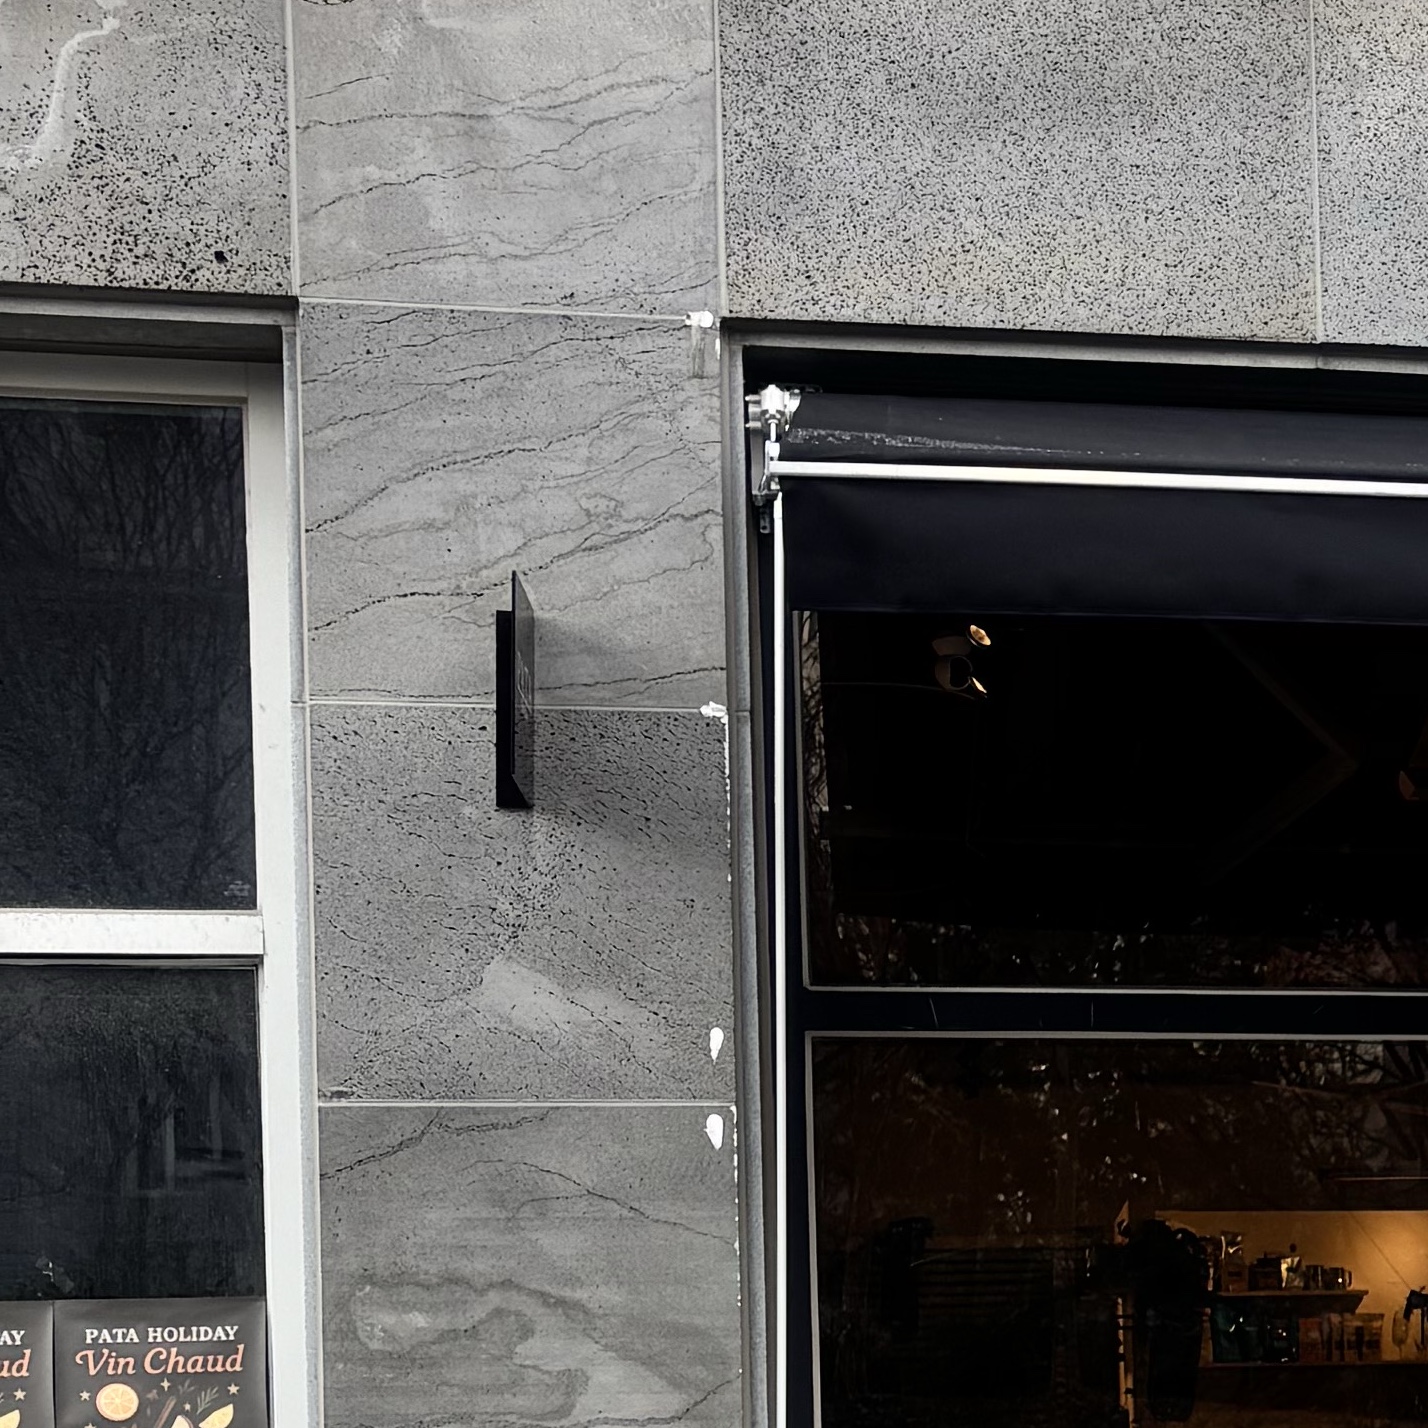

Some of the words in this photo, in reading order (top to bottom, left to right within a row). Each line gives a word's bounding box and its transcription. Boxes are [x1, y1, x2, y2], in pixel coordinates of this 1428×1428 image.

[84, 1327, 140, 1345] PATA
[147, 1325, 239, 1343] HOLIDAY
[75, 1347, 136, 1377] Vin
[143, 1343, 245, 1375] Chaud
